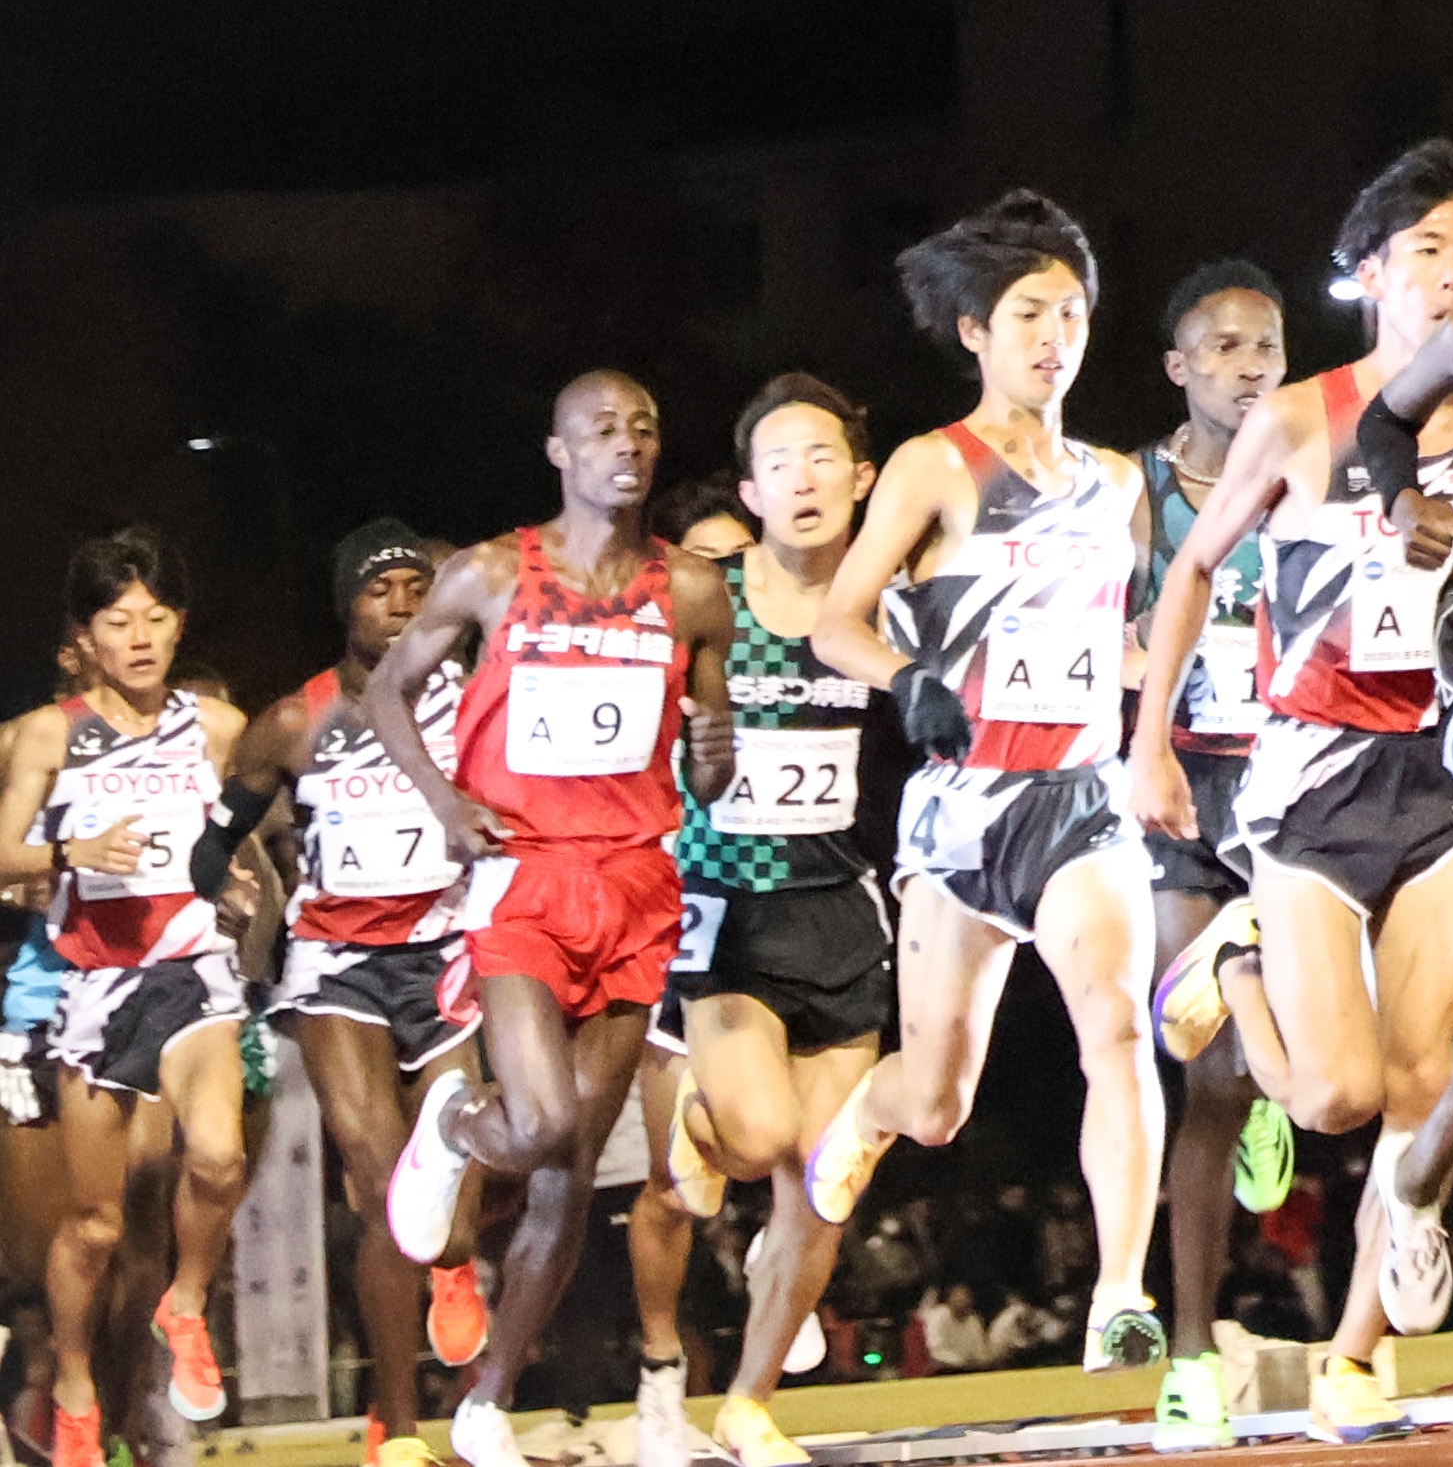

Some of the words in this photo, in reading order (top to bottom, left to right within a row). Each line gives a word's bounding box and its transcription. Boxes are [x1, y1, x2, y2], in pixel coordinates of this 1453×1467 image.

[1373, 605, 1402, 639] A
[1005, 658, 1032, 690] A
[1066, 648, 1095, 692] 4
[726, 674, 870, 709] らまつ病院
[529, 716, 553, 744] A
[592, 702, 622, 746] 9
[83, 773, 202, 795] TOYOTA
[325, 772, 416, 801] TOYO
[730, 776, 755, 805] A
[776, 763, 840, 806] 22
[909, 795, 940, 857] 4
[149, 831, 173, 868] 5
[340, 846, 362, 870] A
[396, 827, 424, 867] 7
